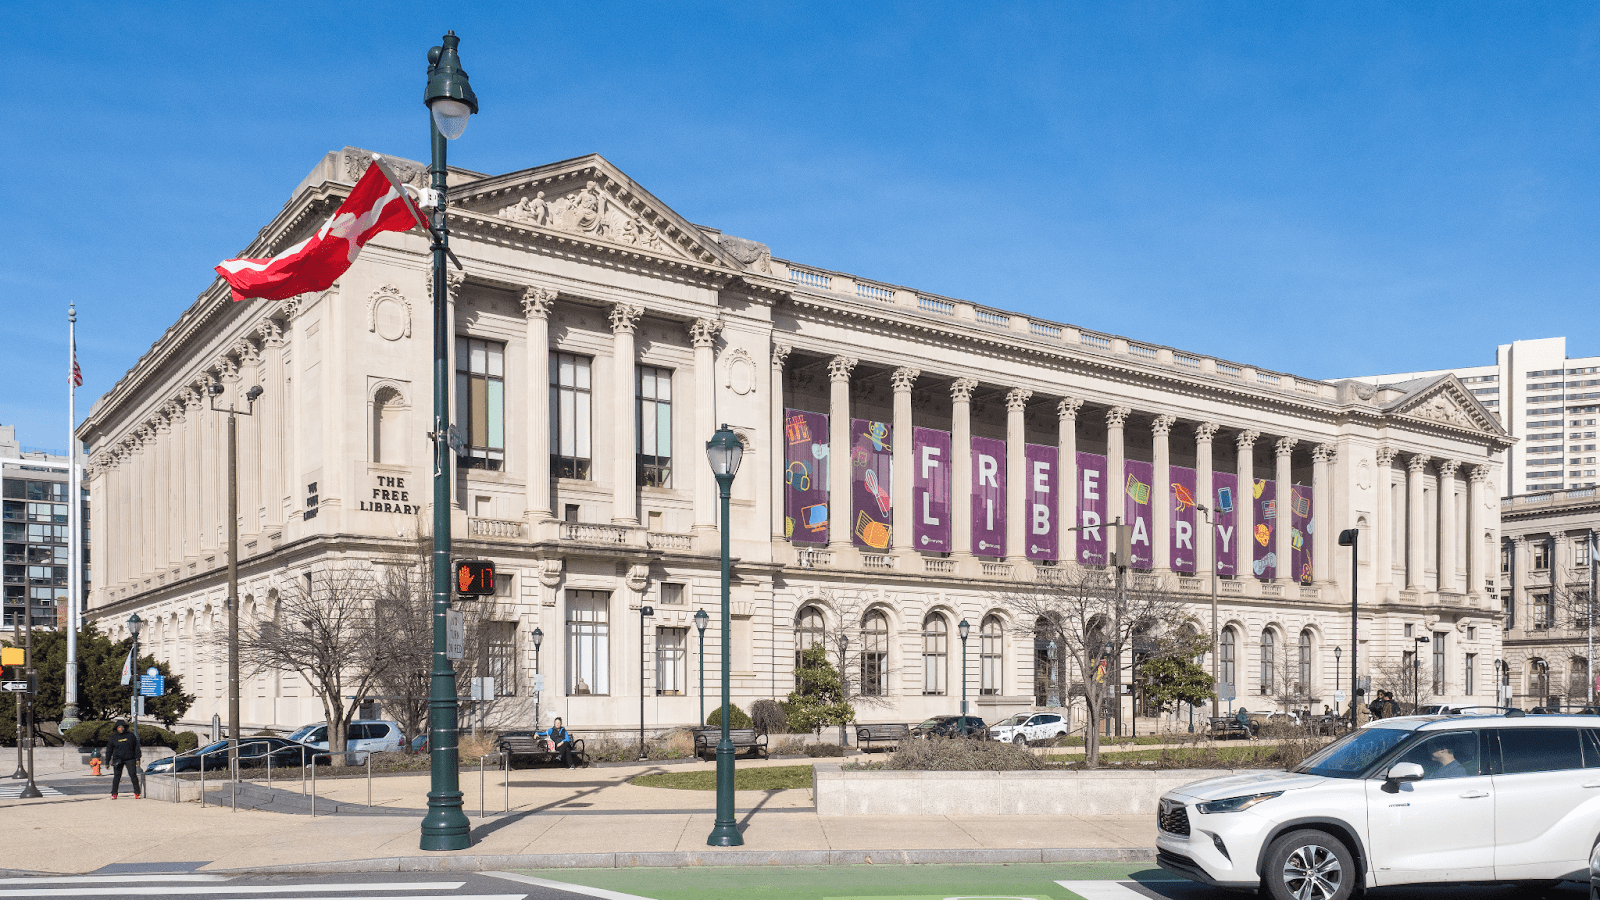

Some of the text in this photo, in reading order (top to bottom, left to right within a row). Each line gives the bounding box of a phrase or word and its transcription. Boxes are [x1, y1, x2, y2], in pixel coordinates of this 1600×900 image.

[377, 475, 405, 488] THE
[372, 488, 409, 502] FREE
[360, 500, 421, 515] LIBRARY
[481, 568, 493, 588] 17
